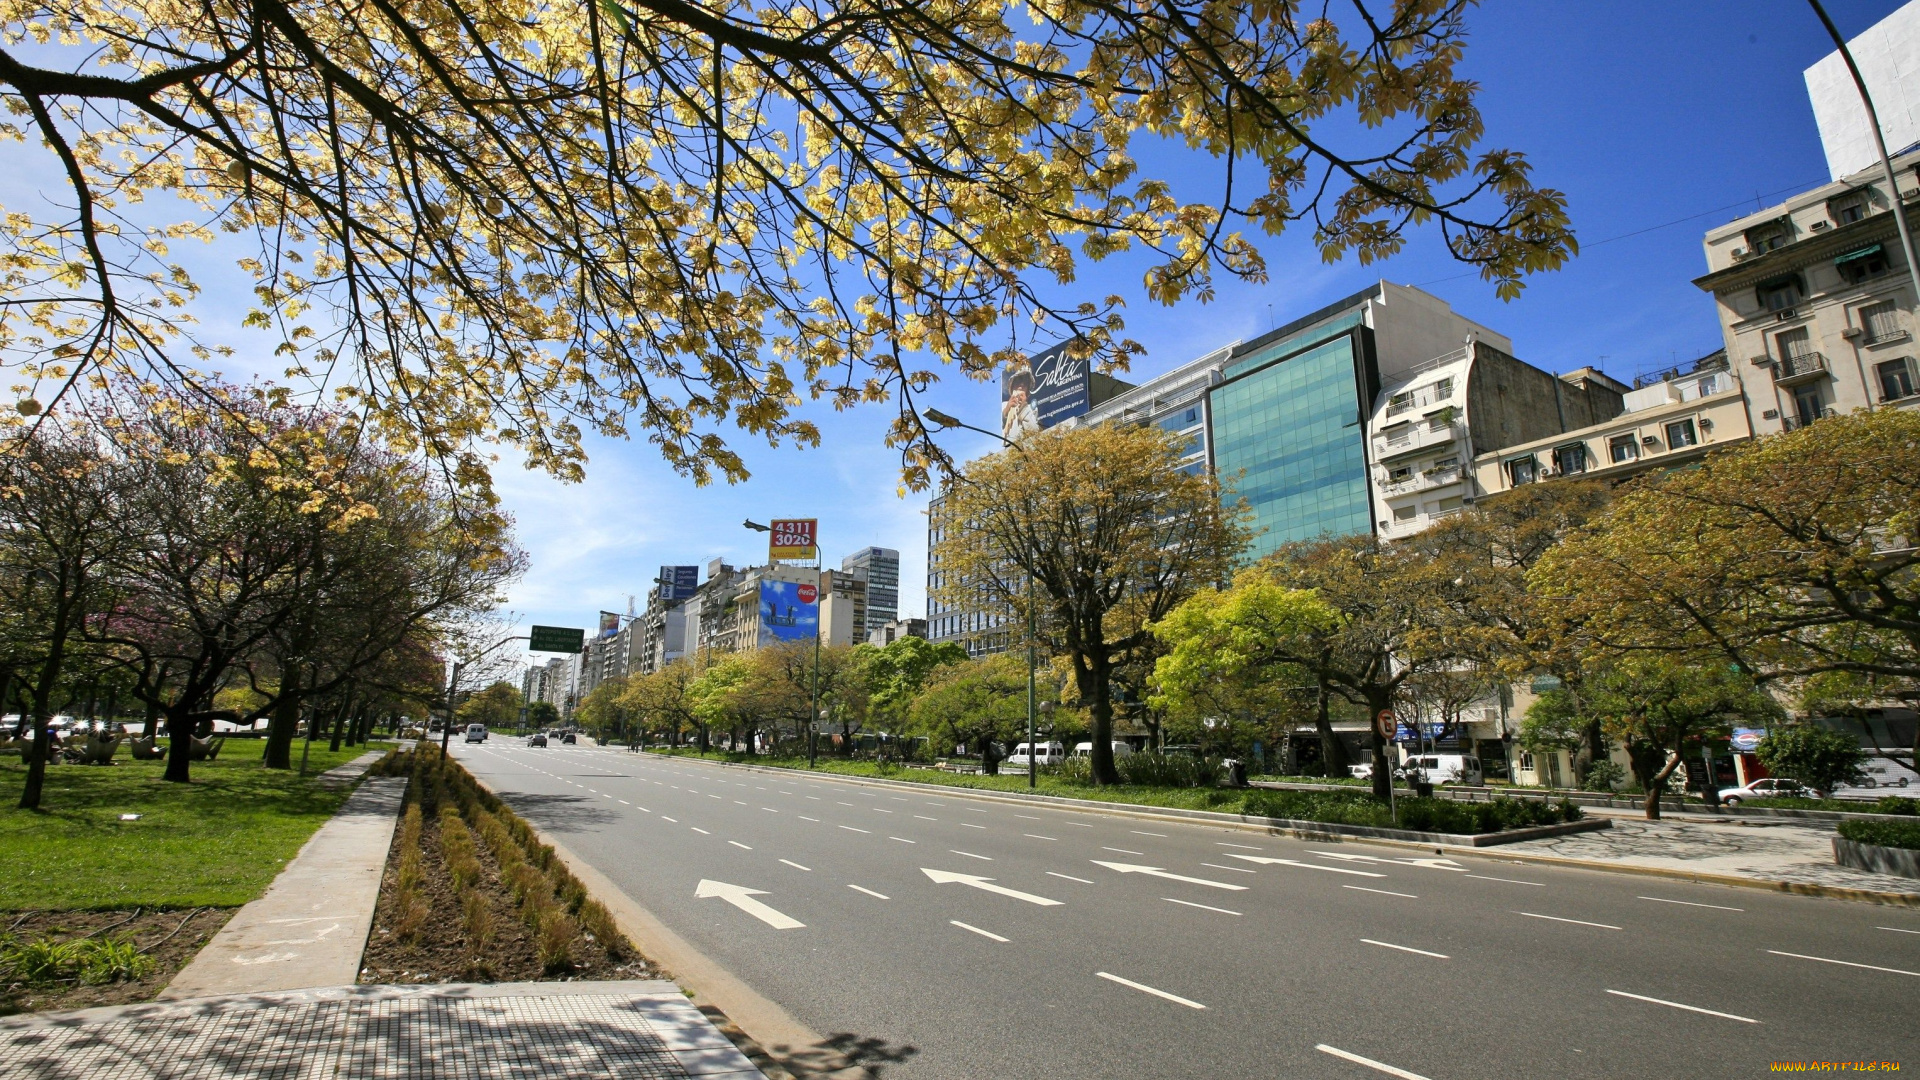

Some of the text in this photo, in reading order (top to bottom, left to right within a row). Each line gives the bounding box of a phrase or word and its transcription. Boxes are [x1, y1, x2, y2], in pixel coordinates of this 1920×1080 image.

[1030, 350, 1083, 394] Salta
[1056, 373, 1083, 387] ARGENTINA
[775, 522, 810, 534] 4311
[775, 533, 811, 545] 3020
